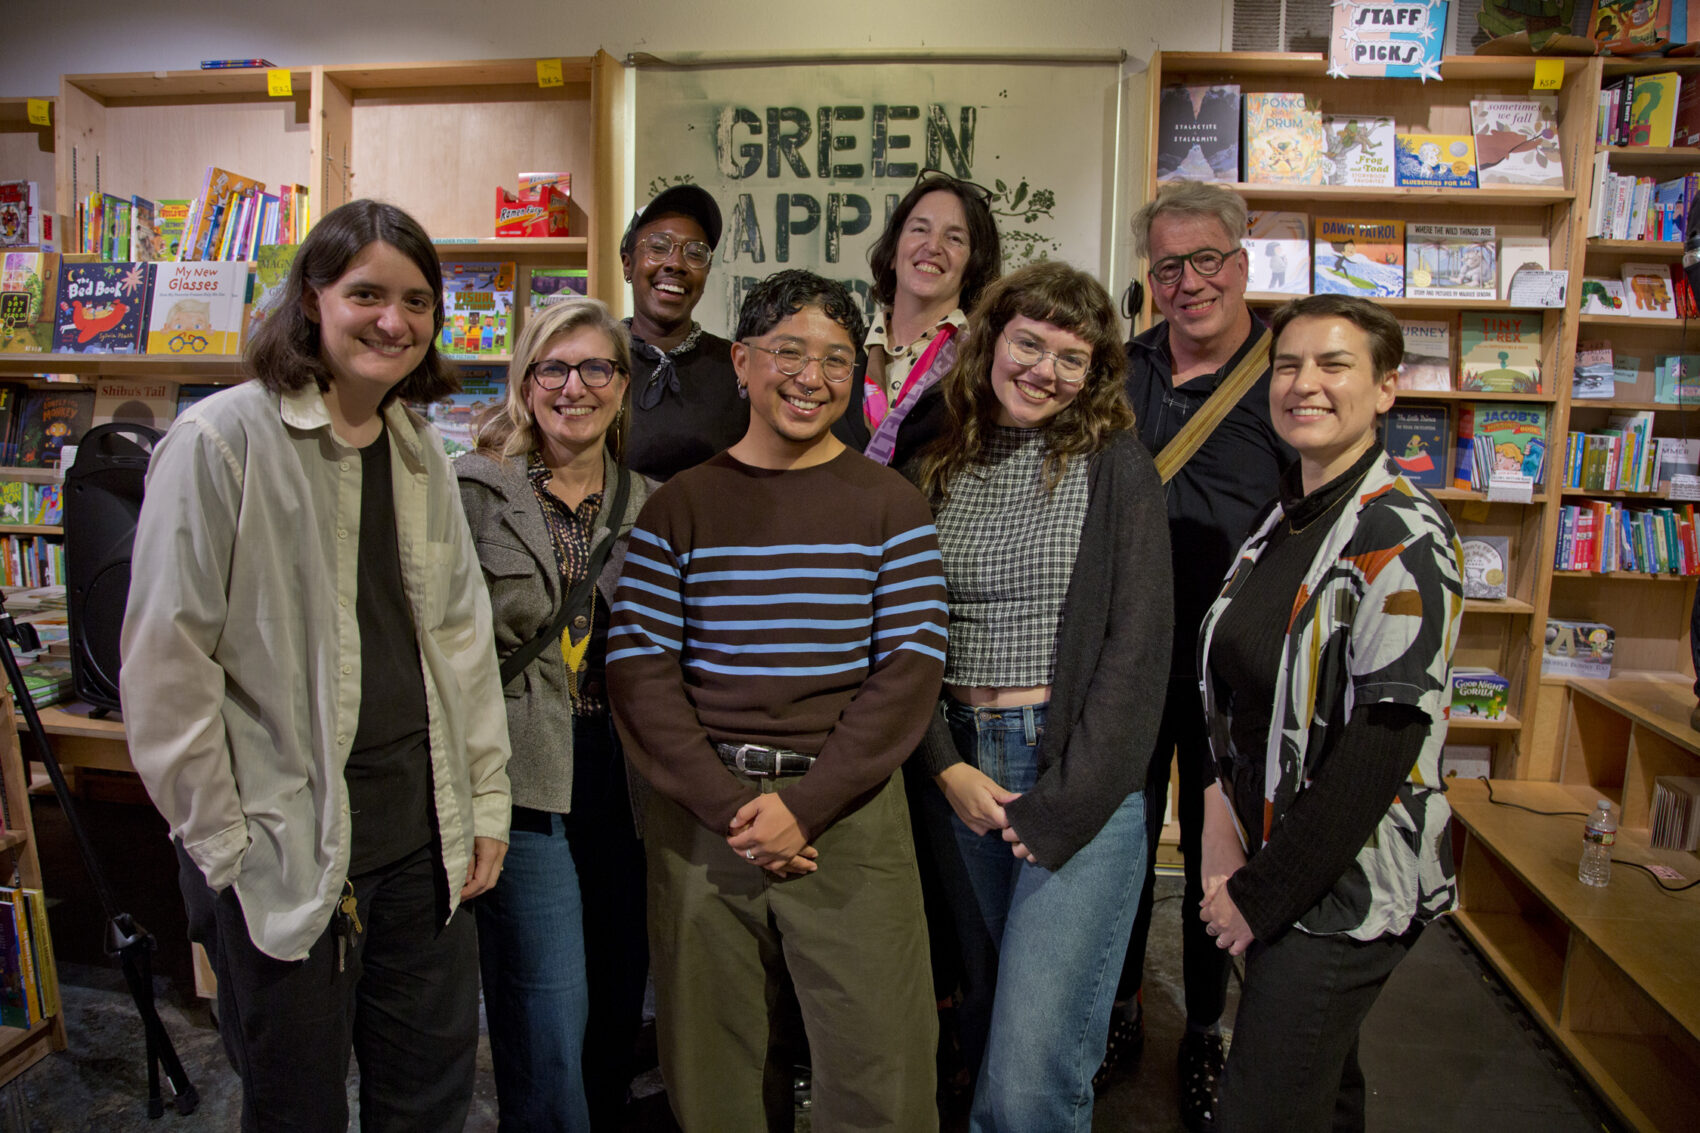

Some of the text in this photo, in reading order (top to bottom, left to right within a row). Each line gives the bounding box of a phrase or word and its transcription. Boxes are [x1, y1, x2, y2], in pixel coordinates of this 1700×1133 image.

[1355, 8, 1422, 26] STAFF
[1355, 44, 1418, 63] PICKS
[1487, 102, 1541, 112] sometimes
[1266, 118, 1303, 128] DRUM
[1511, 112, 1532, 125] fall
[717, 104, 977, 179] GREEN
[1355, 155, 1383, 166] Frog
[1363, 164, 1389, 173] Toad
[1402, 178, 1442, 187] BLUEBERRIES
[1459, 179, 1472, 187] SAL
[500, 204, 544, 222] Ramen Fury
[1322, 221, 1396, 239] DAWN PATROL
[1414, 225, 1491, 236] WHERE THE WILD THINGS ARE
[176, 266, 218, 280] My New
[68, 280, 122, 299] Bed Book
[168, 278, 219, 292] Glasses
[455, 292, 495, 303] VISUAL
[1482, 318, 1522, 332] TINY
[1495, 332, 1521, 343] REX
[102, 386, 166, 398] Shibu's Tail
[1483, 410, 1540, 424] JACOB'S
[1455, 679, 1478, 689] GOOD
[1459, 688, 1494, 698] GORILLA
